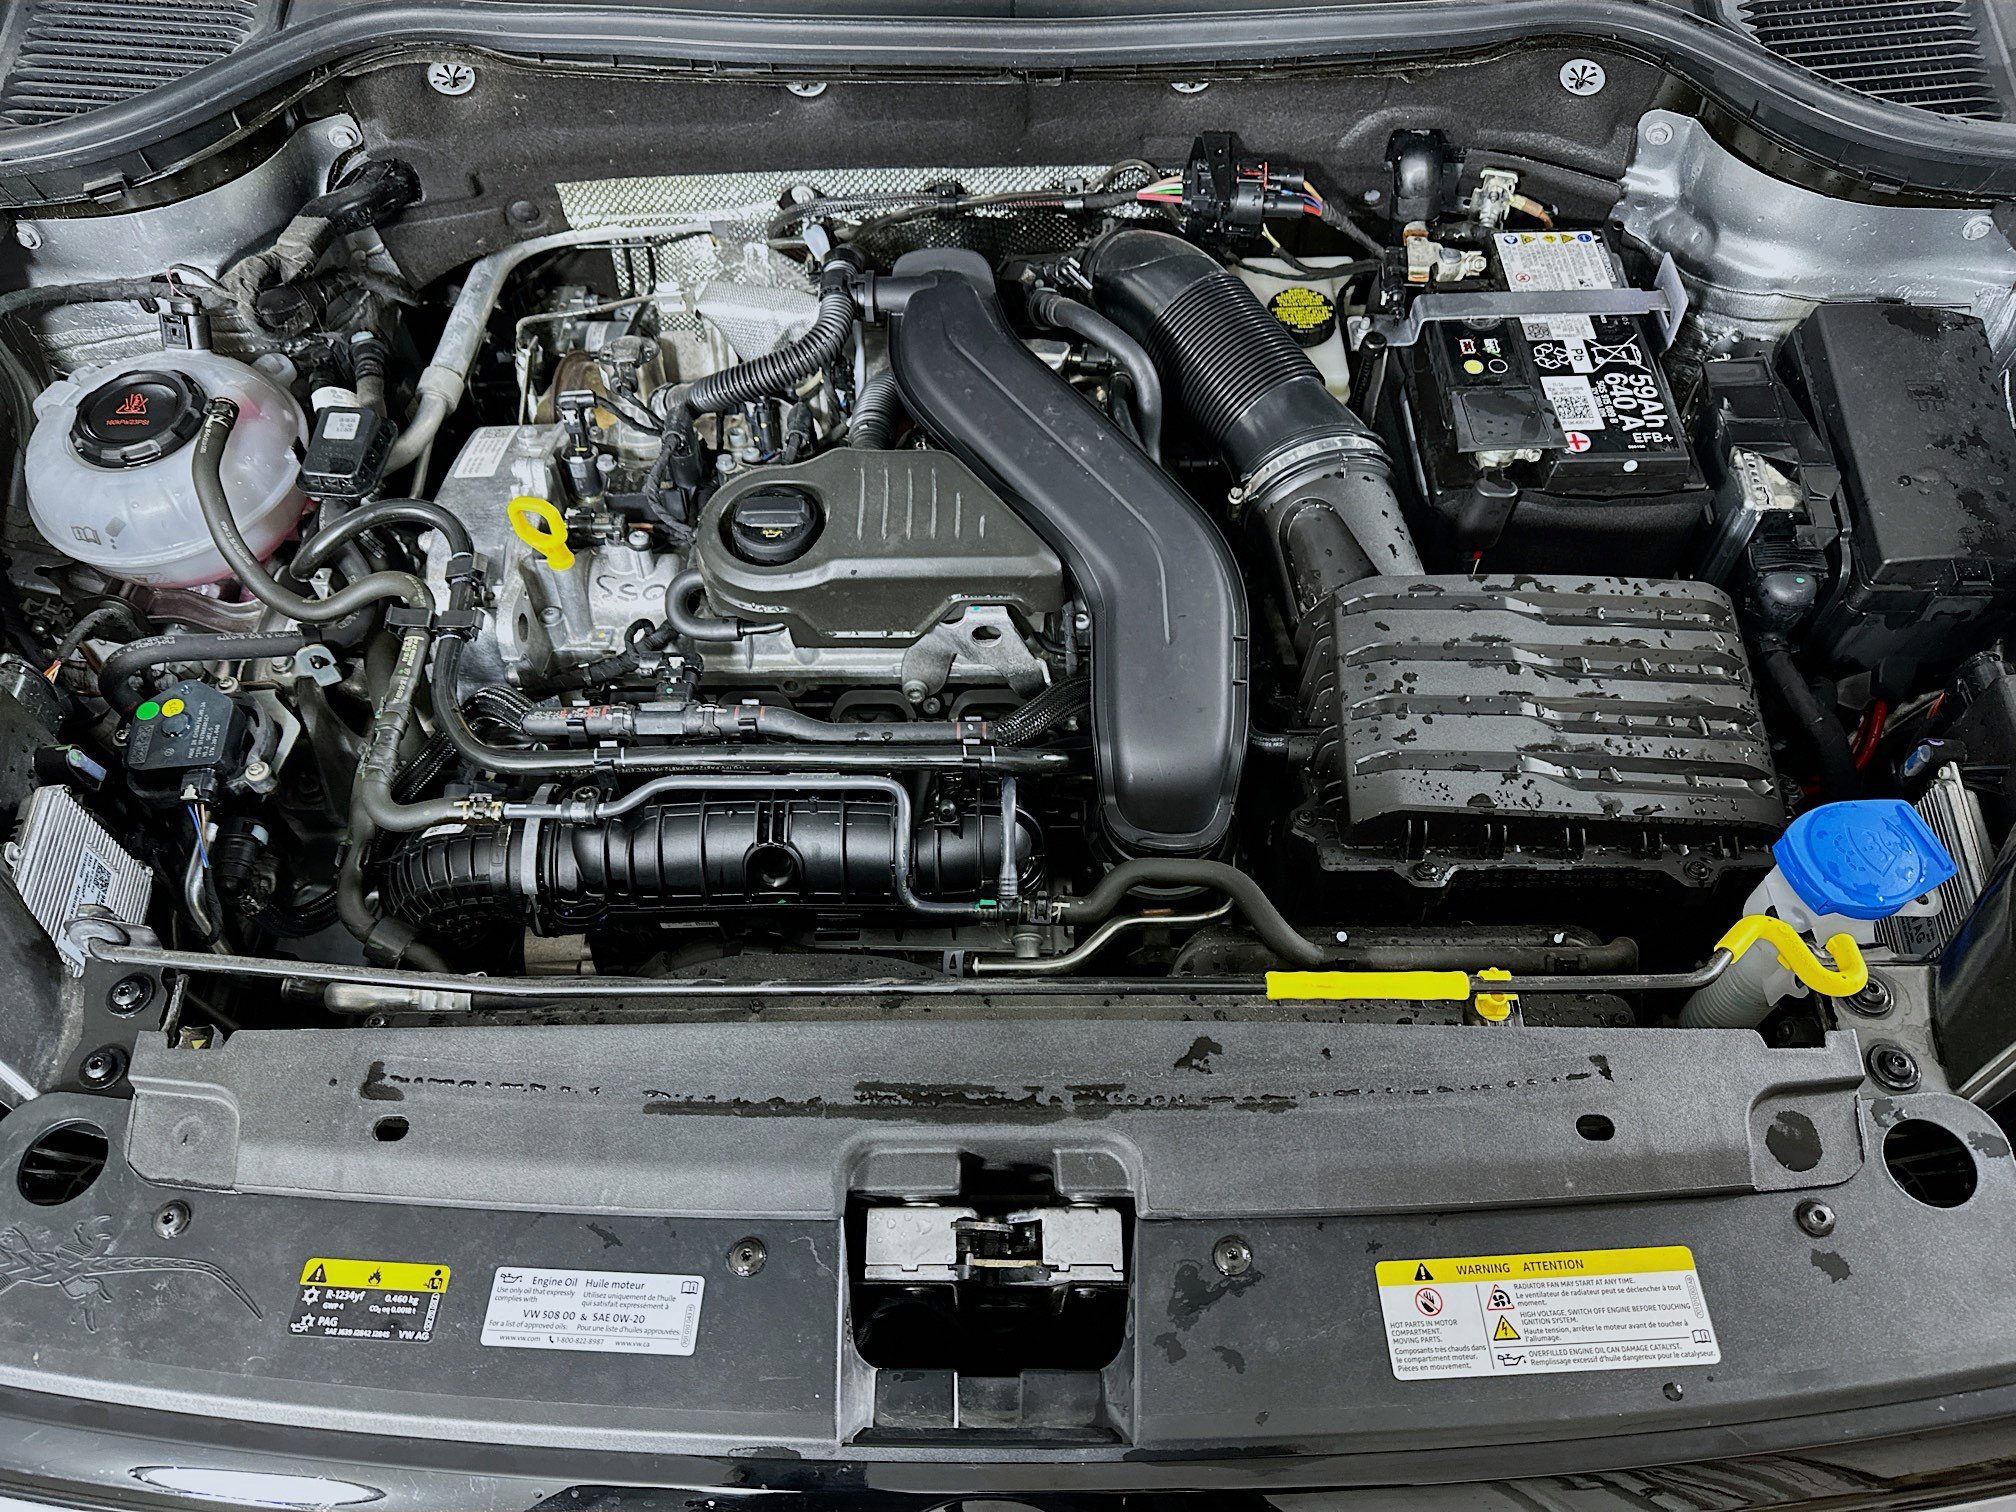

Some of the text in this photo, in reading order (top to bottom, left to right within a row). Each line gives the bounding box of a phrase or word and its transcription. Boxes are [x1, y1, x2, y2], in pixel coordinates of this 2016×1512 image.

[1571, 349, 1586, 362] Pb
[1604, 372, 1638, 410] 640
[1629, 374, 1668, 428] 59Ah
[1618, 414, 1645, 431] A
[1632, 432, 1674, 443] EFB+
[1456, 1259, 1584, 1275] WARNING ATTENTION
[532, 1276, 645, 1290] Engine Oil Huile moteur
[326, 1289, 366, 1303] R-1234yf
[546, 1289, 575, 1298] expressly
[1525, 1290, 1560, 1298] ventilateur
[1626, 1284, 1660, 1293] déclencher
[384, 1294, 420, 1306] 0.460 kg
[494, 1295, 522, 1303] complies
[608, 1293, 646, 1302] uniquement
[657, 1294, 676, 1302] l'huile
[620, 1301, 663, 1310] expressément
[318, 1316, 339, 1327] PAG
[523, 1310, 540, 1318] VW
[543, 1310, 560, 1319] 508
[562, 1312, 576, 1320] 00
[593, 1313, 610, 1322] SAE
[613, 1314, 646, 1323] 0W-20
[524, 1322, 554, 1330] approved
[324, 1328, 337, 1336] SAE
[398, 1330, 430, 1340] VW AG
[556, 1337, 604, 1345] 1-800-822-8987
[1394, 1348, 1434, 1356] Composants
[1528, 1349, 1568, 1357] OVERFILLED
[1650, 1343, 1683, 1351] CATALYST.
[1404, 1355, 1450, 1365] compartiment
[1531, 1358, 1571, 1366] Remplissage
[1572, 1356, 1598, 1364] excessif
[1600, 1354, 1620, 1362] d'huile
[1622, 1353, 1656, 1362] dangereux
[1681, 1350, 1716, 1358] catalyseur.
